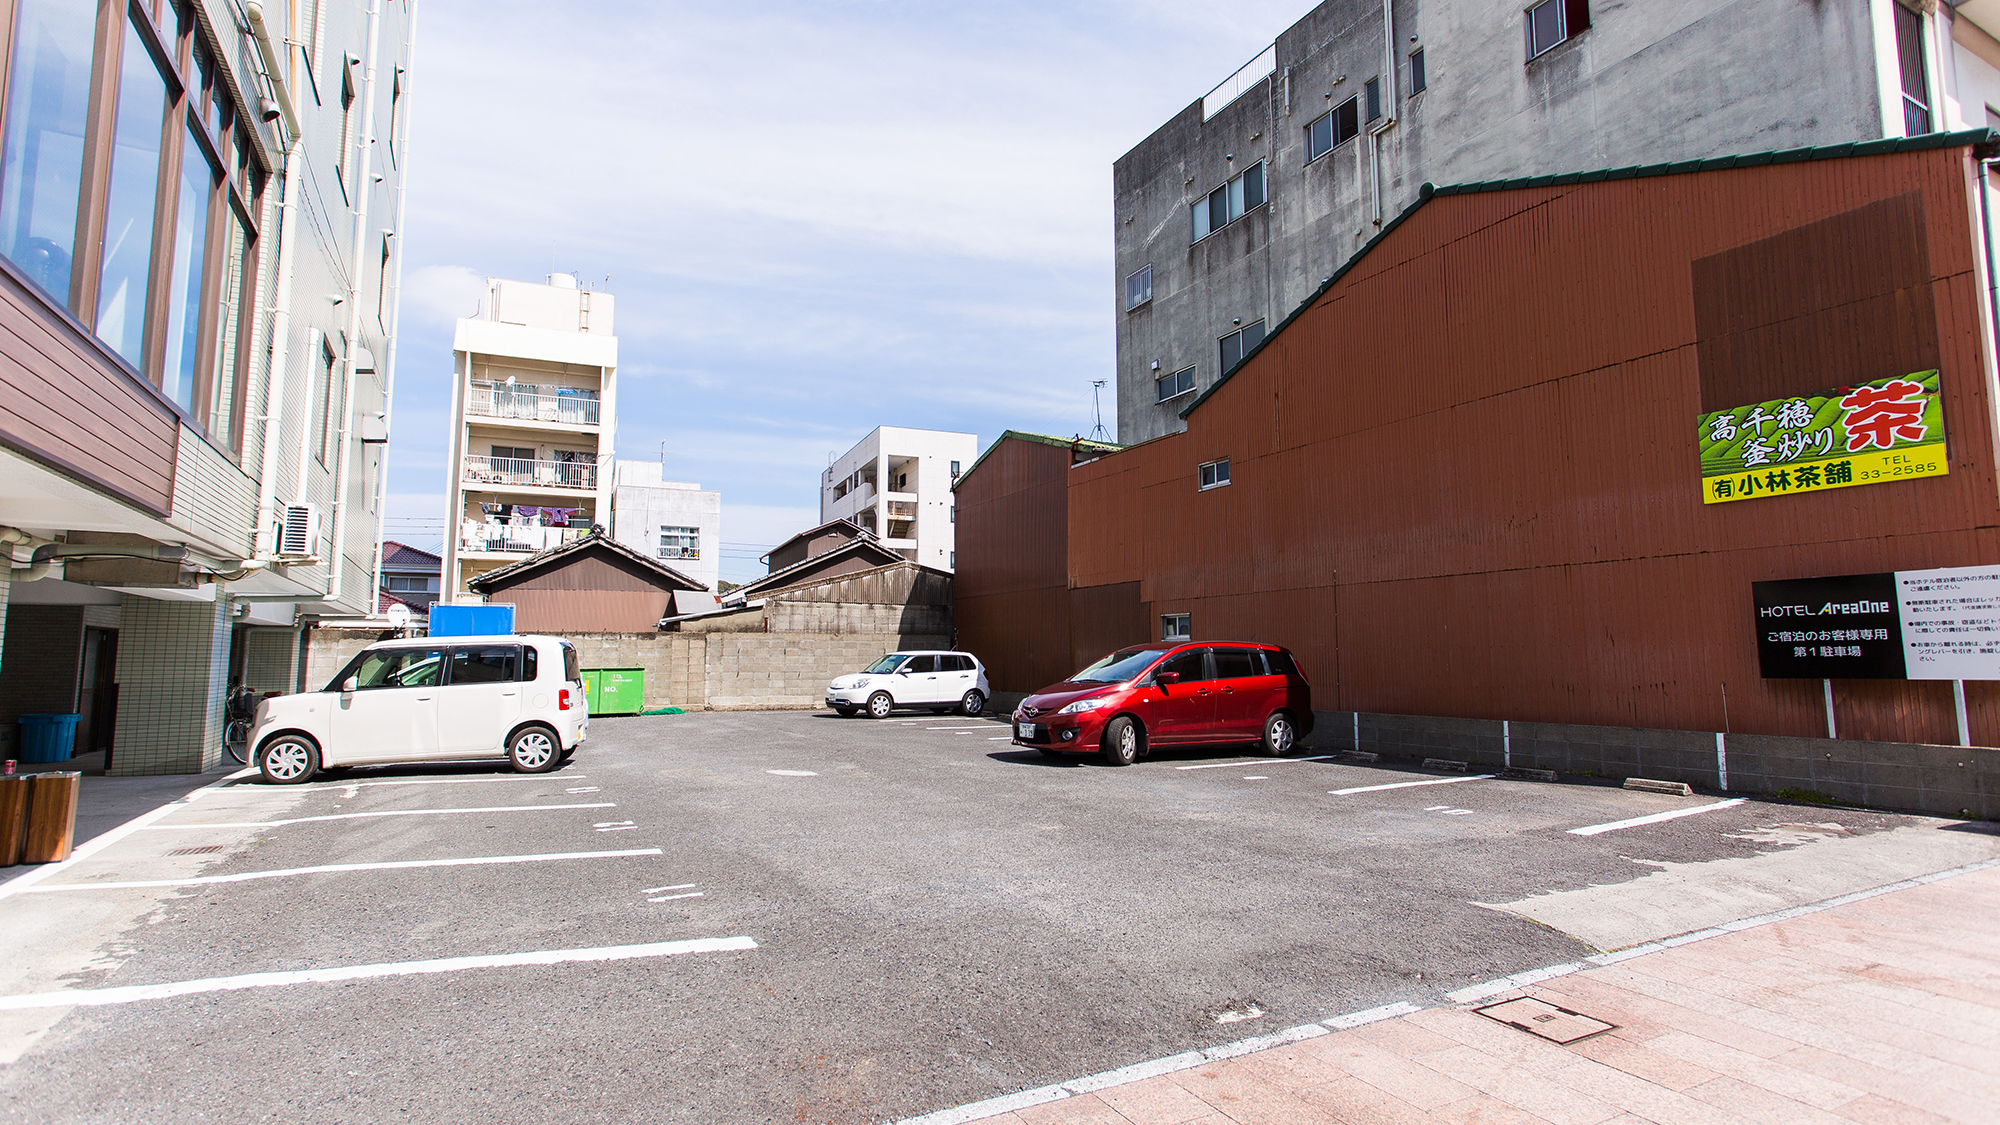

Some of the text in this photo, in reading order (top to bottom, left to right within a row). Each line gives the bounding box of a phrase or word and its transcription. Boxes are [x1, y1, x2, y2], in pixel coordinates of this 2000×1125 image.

[1709, 400, 1814, 442] 高千穂
[1840, 380, 1927, 452] 茶
[1740, 427, 1834, 467] 釜炒り
[1882, 455, 1911, 465] TEL
[1860, 462, 1937, 480] 33-2585
[1760, 600, 1890, 617] HOTEL AreaOne
[1768, 629, 1888, 642] ご宿泊のお客様専用
